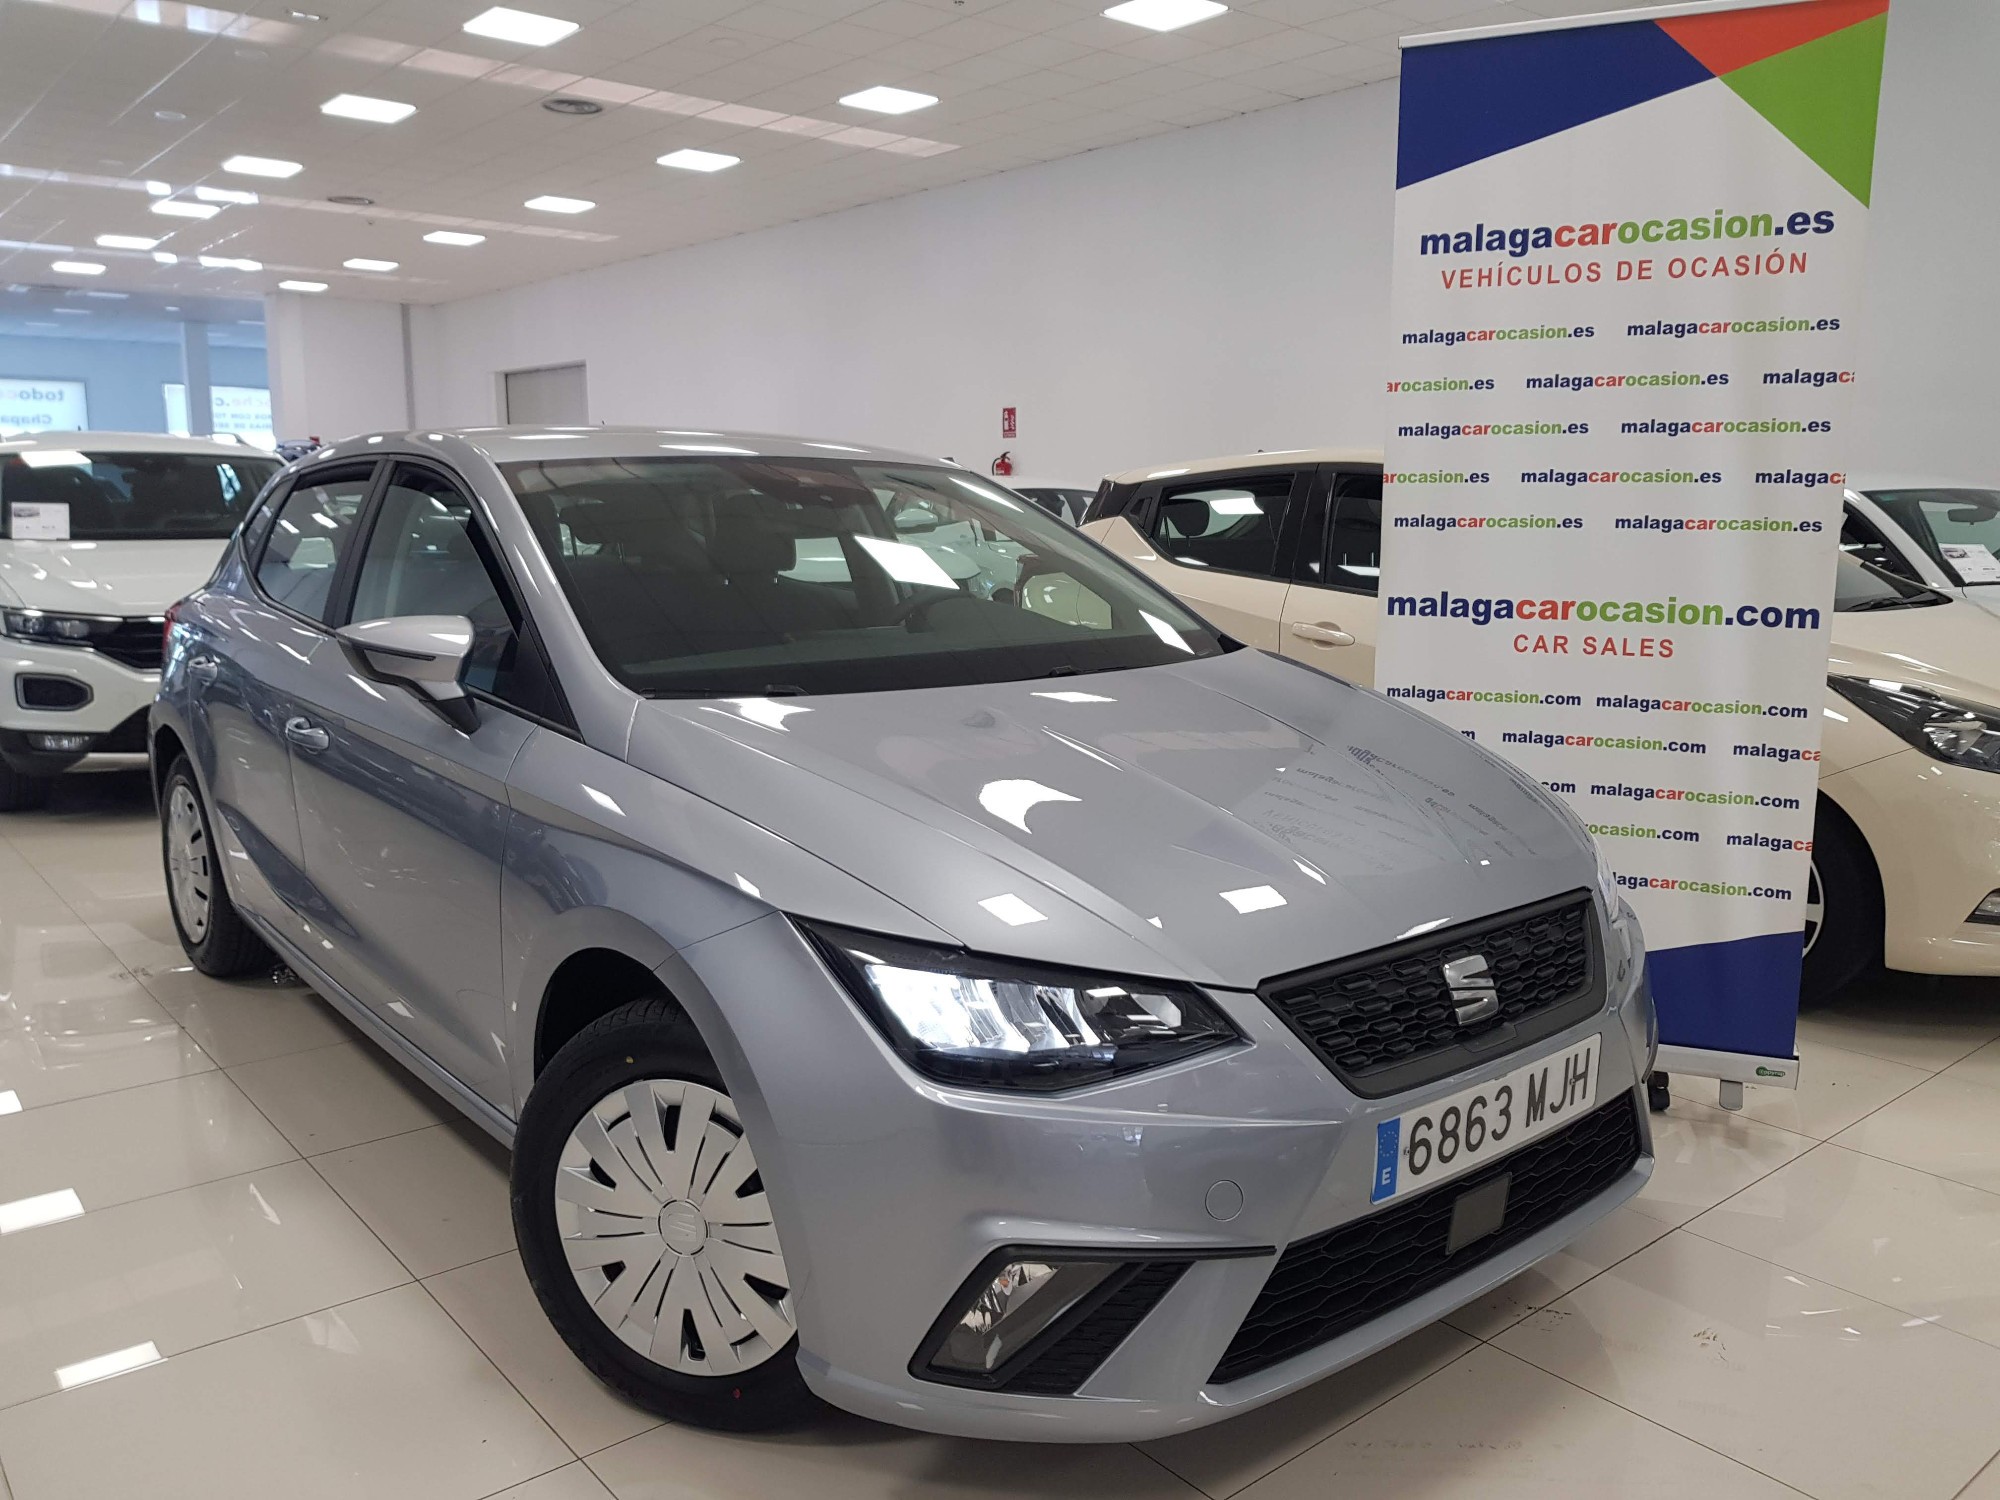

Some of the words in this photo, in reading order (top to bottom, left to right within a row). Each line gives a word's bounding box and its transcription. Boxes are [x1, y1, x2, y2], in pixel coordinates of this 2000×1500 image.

[1420, 209, 1834, 257] malagacarocasion.es
[1442, 261, 1601, 289] VEHÍCULOS
[1617, 260, 1653, 282] DE
[1668, 248, 1807, 279] OCASIÓN
[1402, 324, 1595, 346] malagacarocasion.es
[1627, 316, 1840, 338] malagacarocasion.es
[1526, 370, 1729, 391] malagacarocasion.es
[1398, 421, 1589, 440] malagacarocasion.es
[1621, 418, 1831, 438] malagacarocasion.es
[1521, 469, 1722, 487] malagacarocasion.es
[1394, 514, 1583, 531] malagacarocasion.es
[1615, 514, 1823, 533] malagacarocasion.es
[1387, 591, 1820, 629] malagacarocasion.com
[1513, 634, 1569, 655] CAR
[1583, 636, 1674, 659] SALES
[1386, 684, 1581, 706] malagacarocasion.com
[1596, 694, 1808, 719] malagacarocasion.com
[1502, 729, 1706, 754] malagacarocasion.com
[1590, 782, 1800, 809] malagacarocasion.com
[1586, 824, 1700, 842] ocasion.com
[1408, 1085, 1513, 1176] 6863
[1525, 1047, 1591, 1129] MJH
[1381, 1167, 1392, 1185] E
